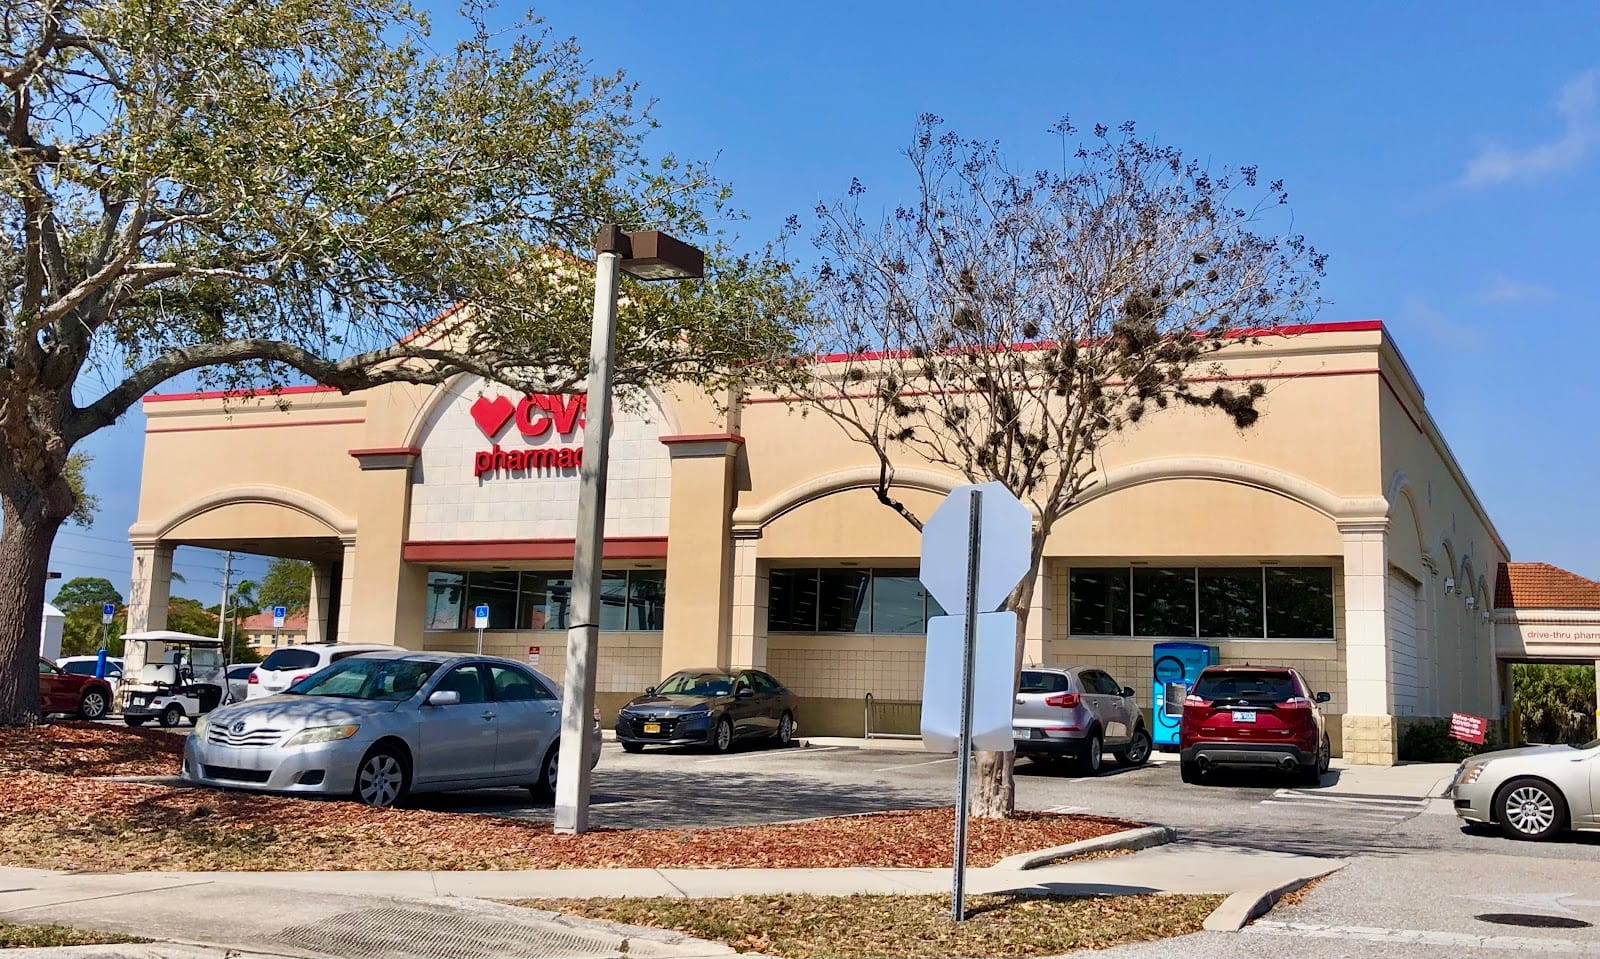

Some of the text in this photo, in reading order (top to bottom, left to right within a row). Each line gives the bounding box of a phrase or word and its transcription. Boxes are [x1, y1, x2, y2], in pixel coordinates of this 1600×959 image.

[515, 393, 587, 436] CV
[474, 444, 584, 477] pharmac
[1527, 631, 1600, 640] drive-thru pharm
